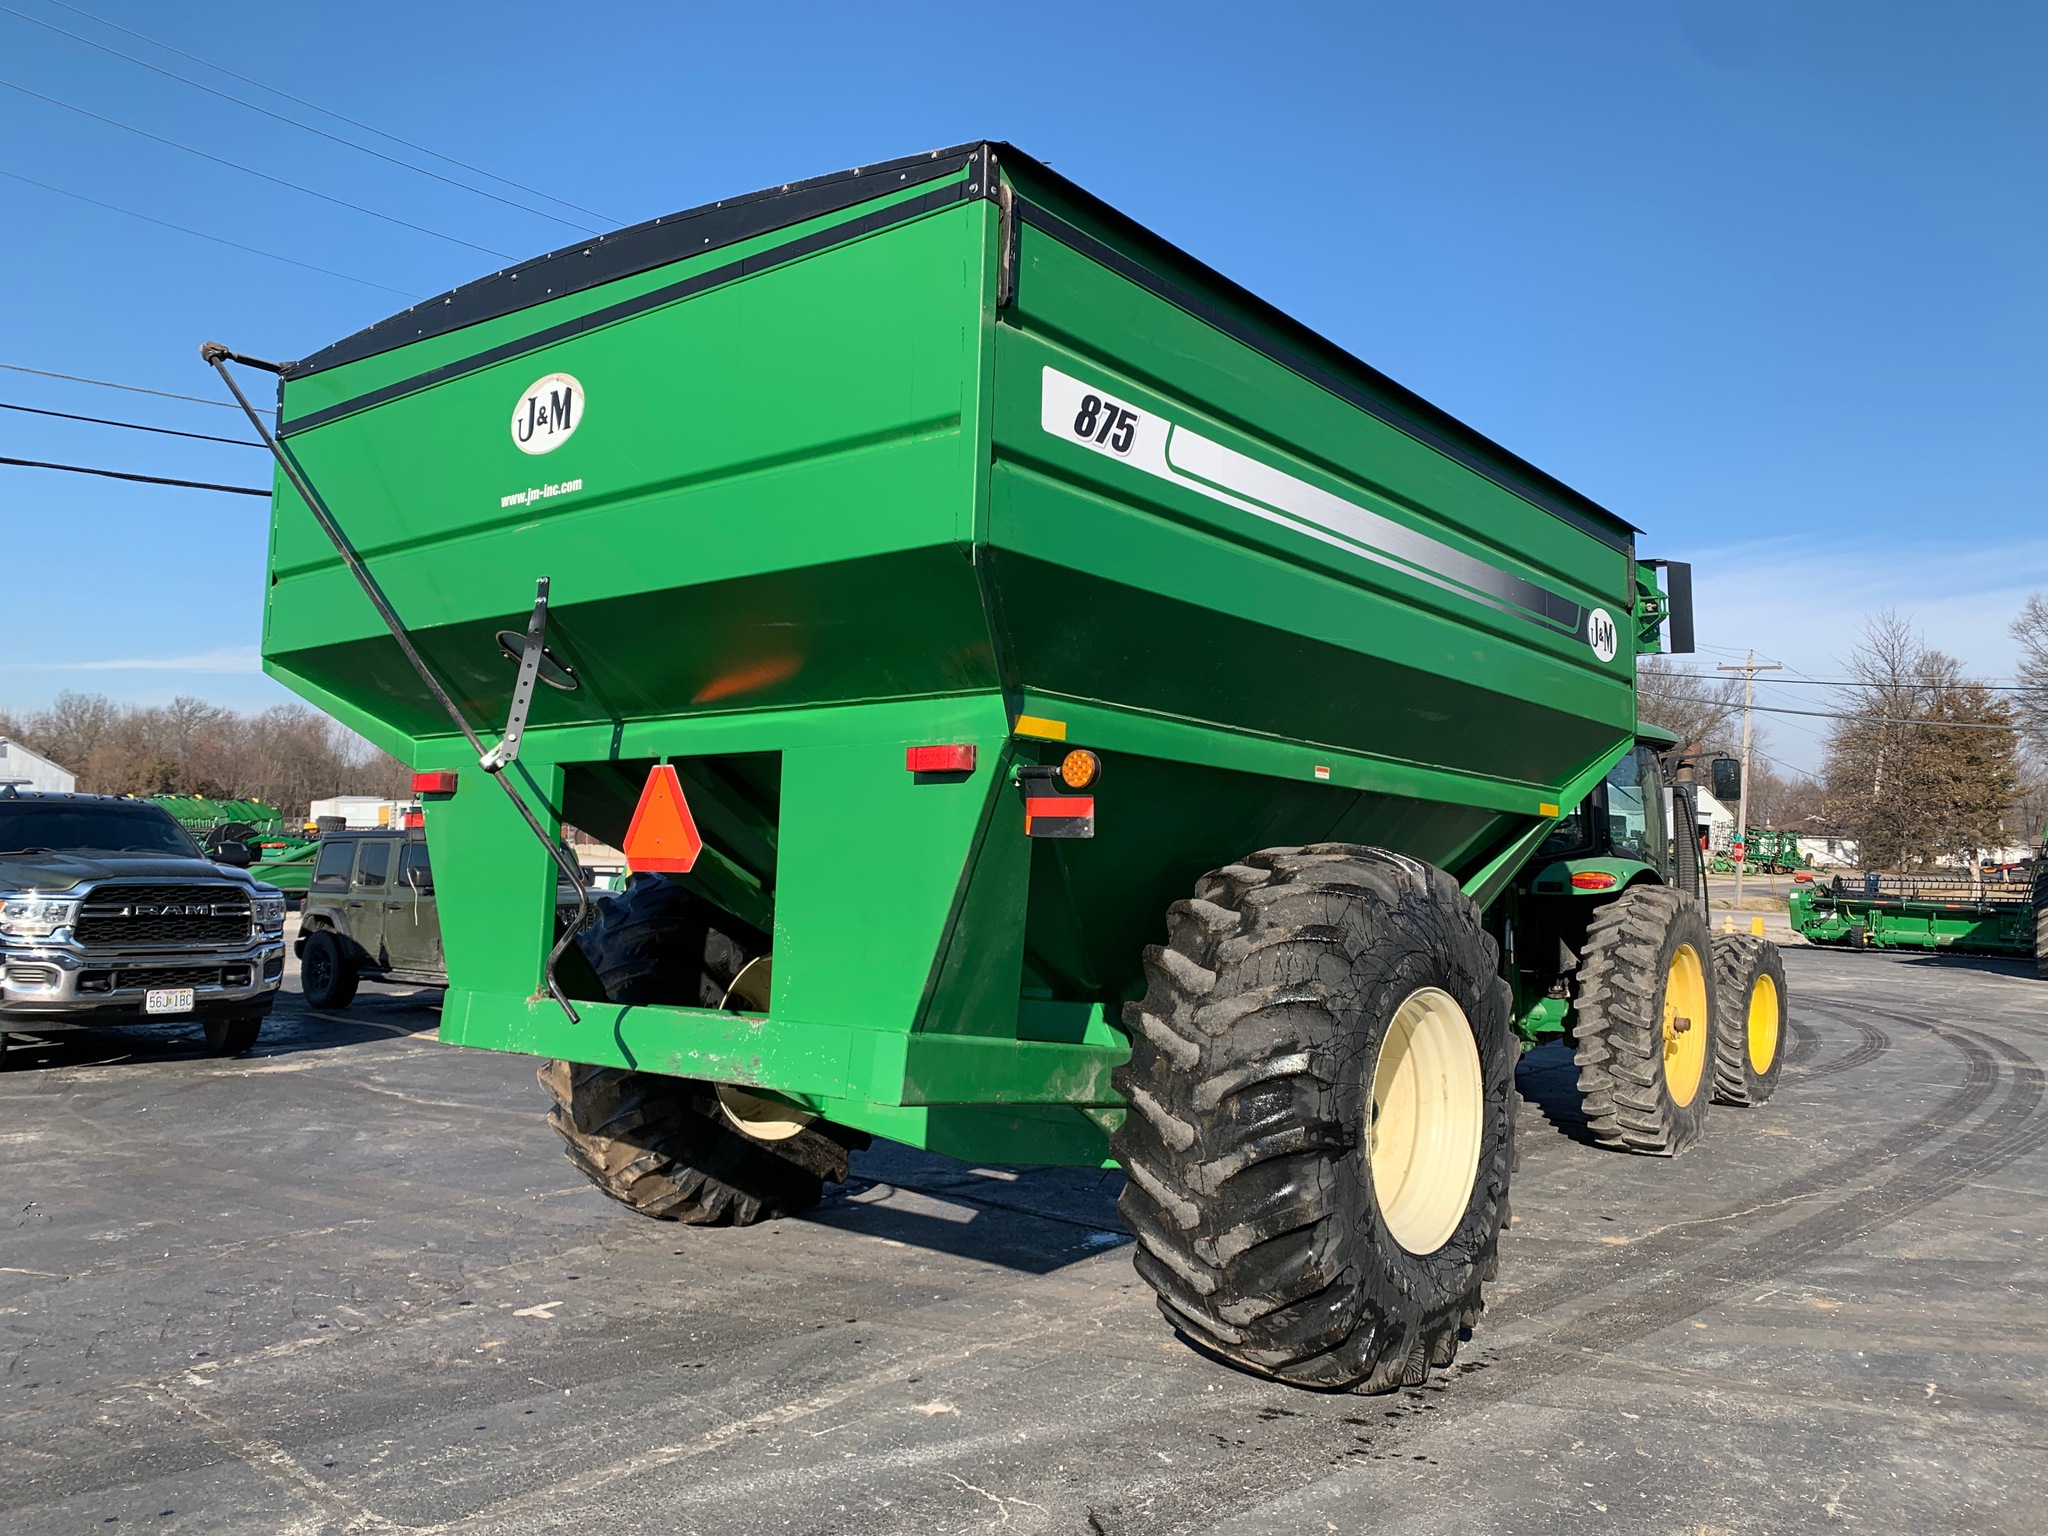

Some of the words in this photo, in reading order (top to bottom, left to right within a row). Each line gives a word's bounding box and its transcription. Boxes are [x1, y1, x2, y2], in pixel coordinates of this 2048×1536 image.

[518, 386, 573, 442] J&M
[1073, 394, 1139, 453] 875
[500, 478, 582, 507] www.jm-inc.com
[1590, 617, 1613, 654] J&M
[135, 905, 208, 915] RAM
